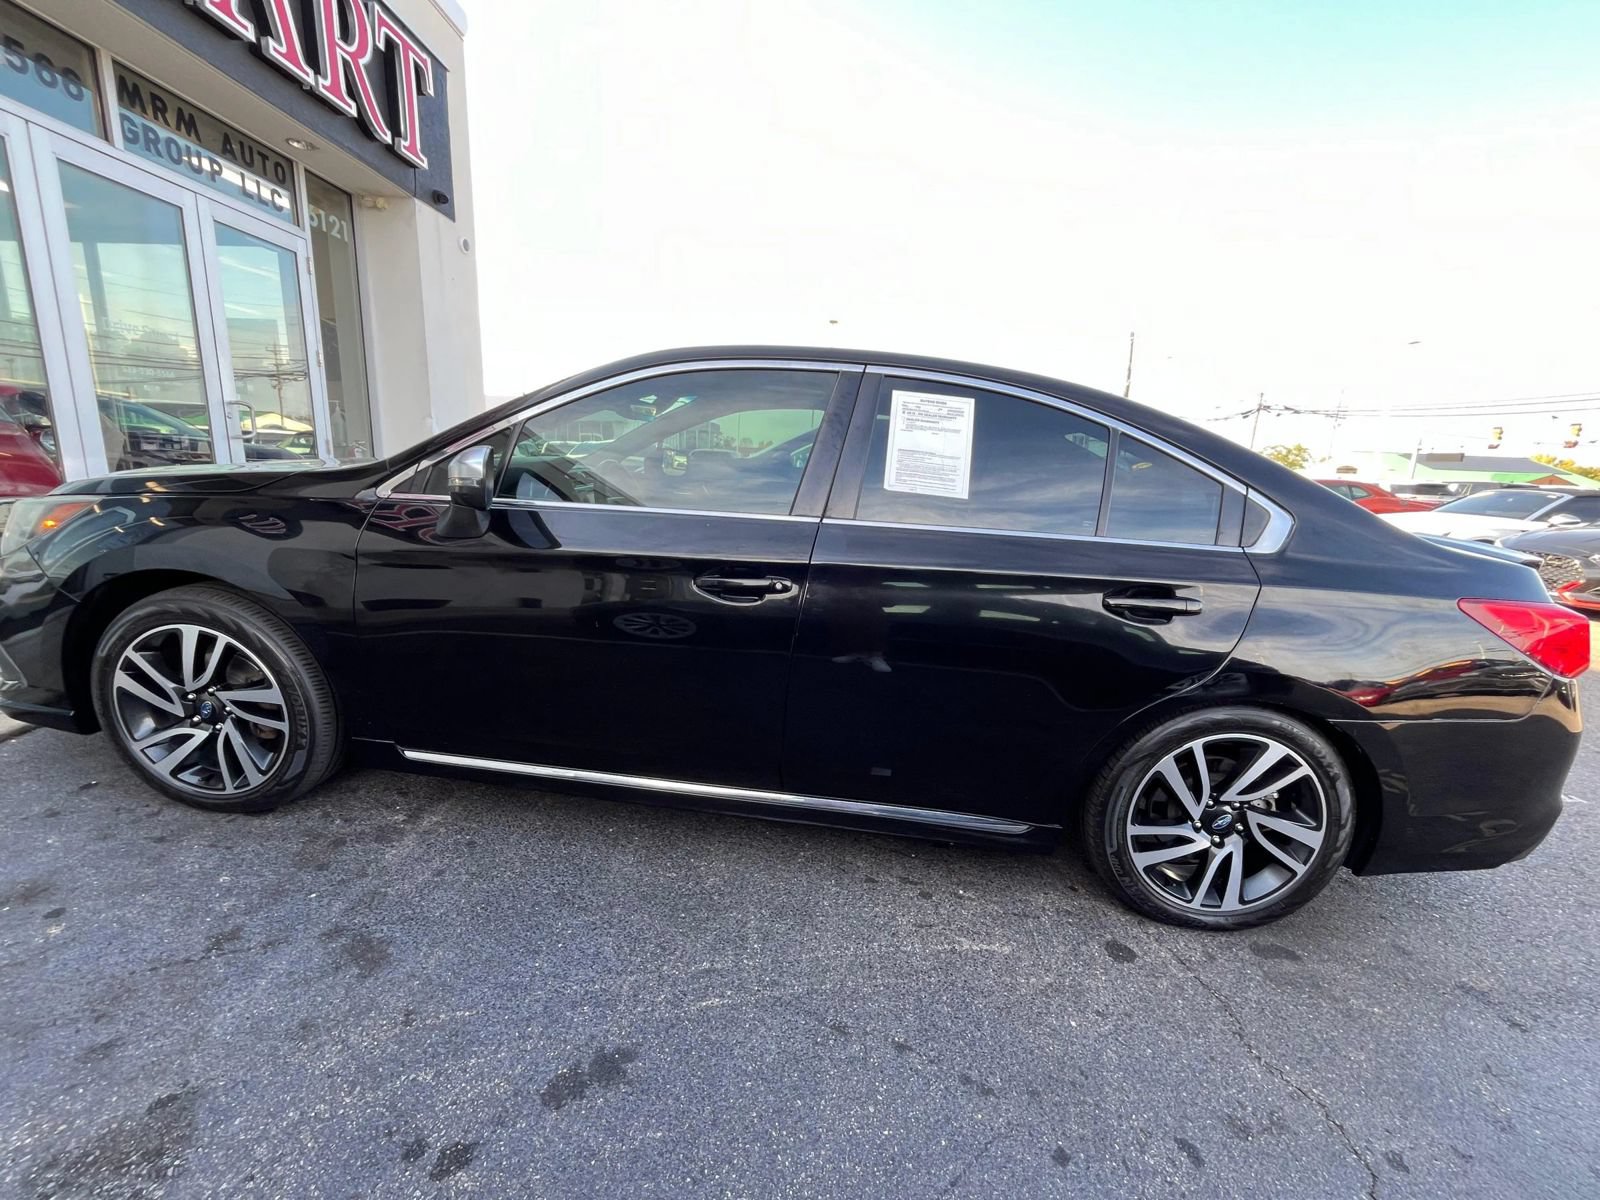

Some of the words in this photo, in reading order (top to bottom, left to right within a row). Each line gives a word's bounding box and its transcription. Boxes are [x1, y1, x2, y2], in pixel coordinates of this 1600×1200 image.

[117, 74, 202, 142] MRM
[221, 131, 287, 185] AUTO
[119, 112, 223, 184] GROUP
[240, 171, 285, 213] LLC
